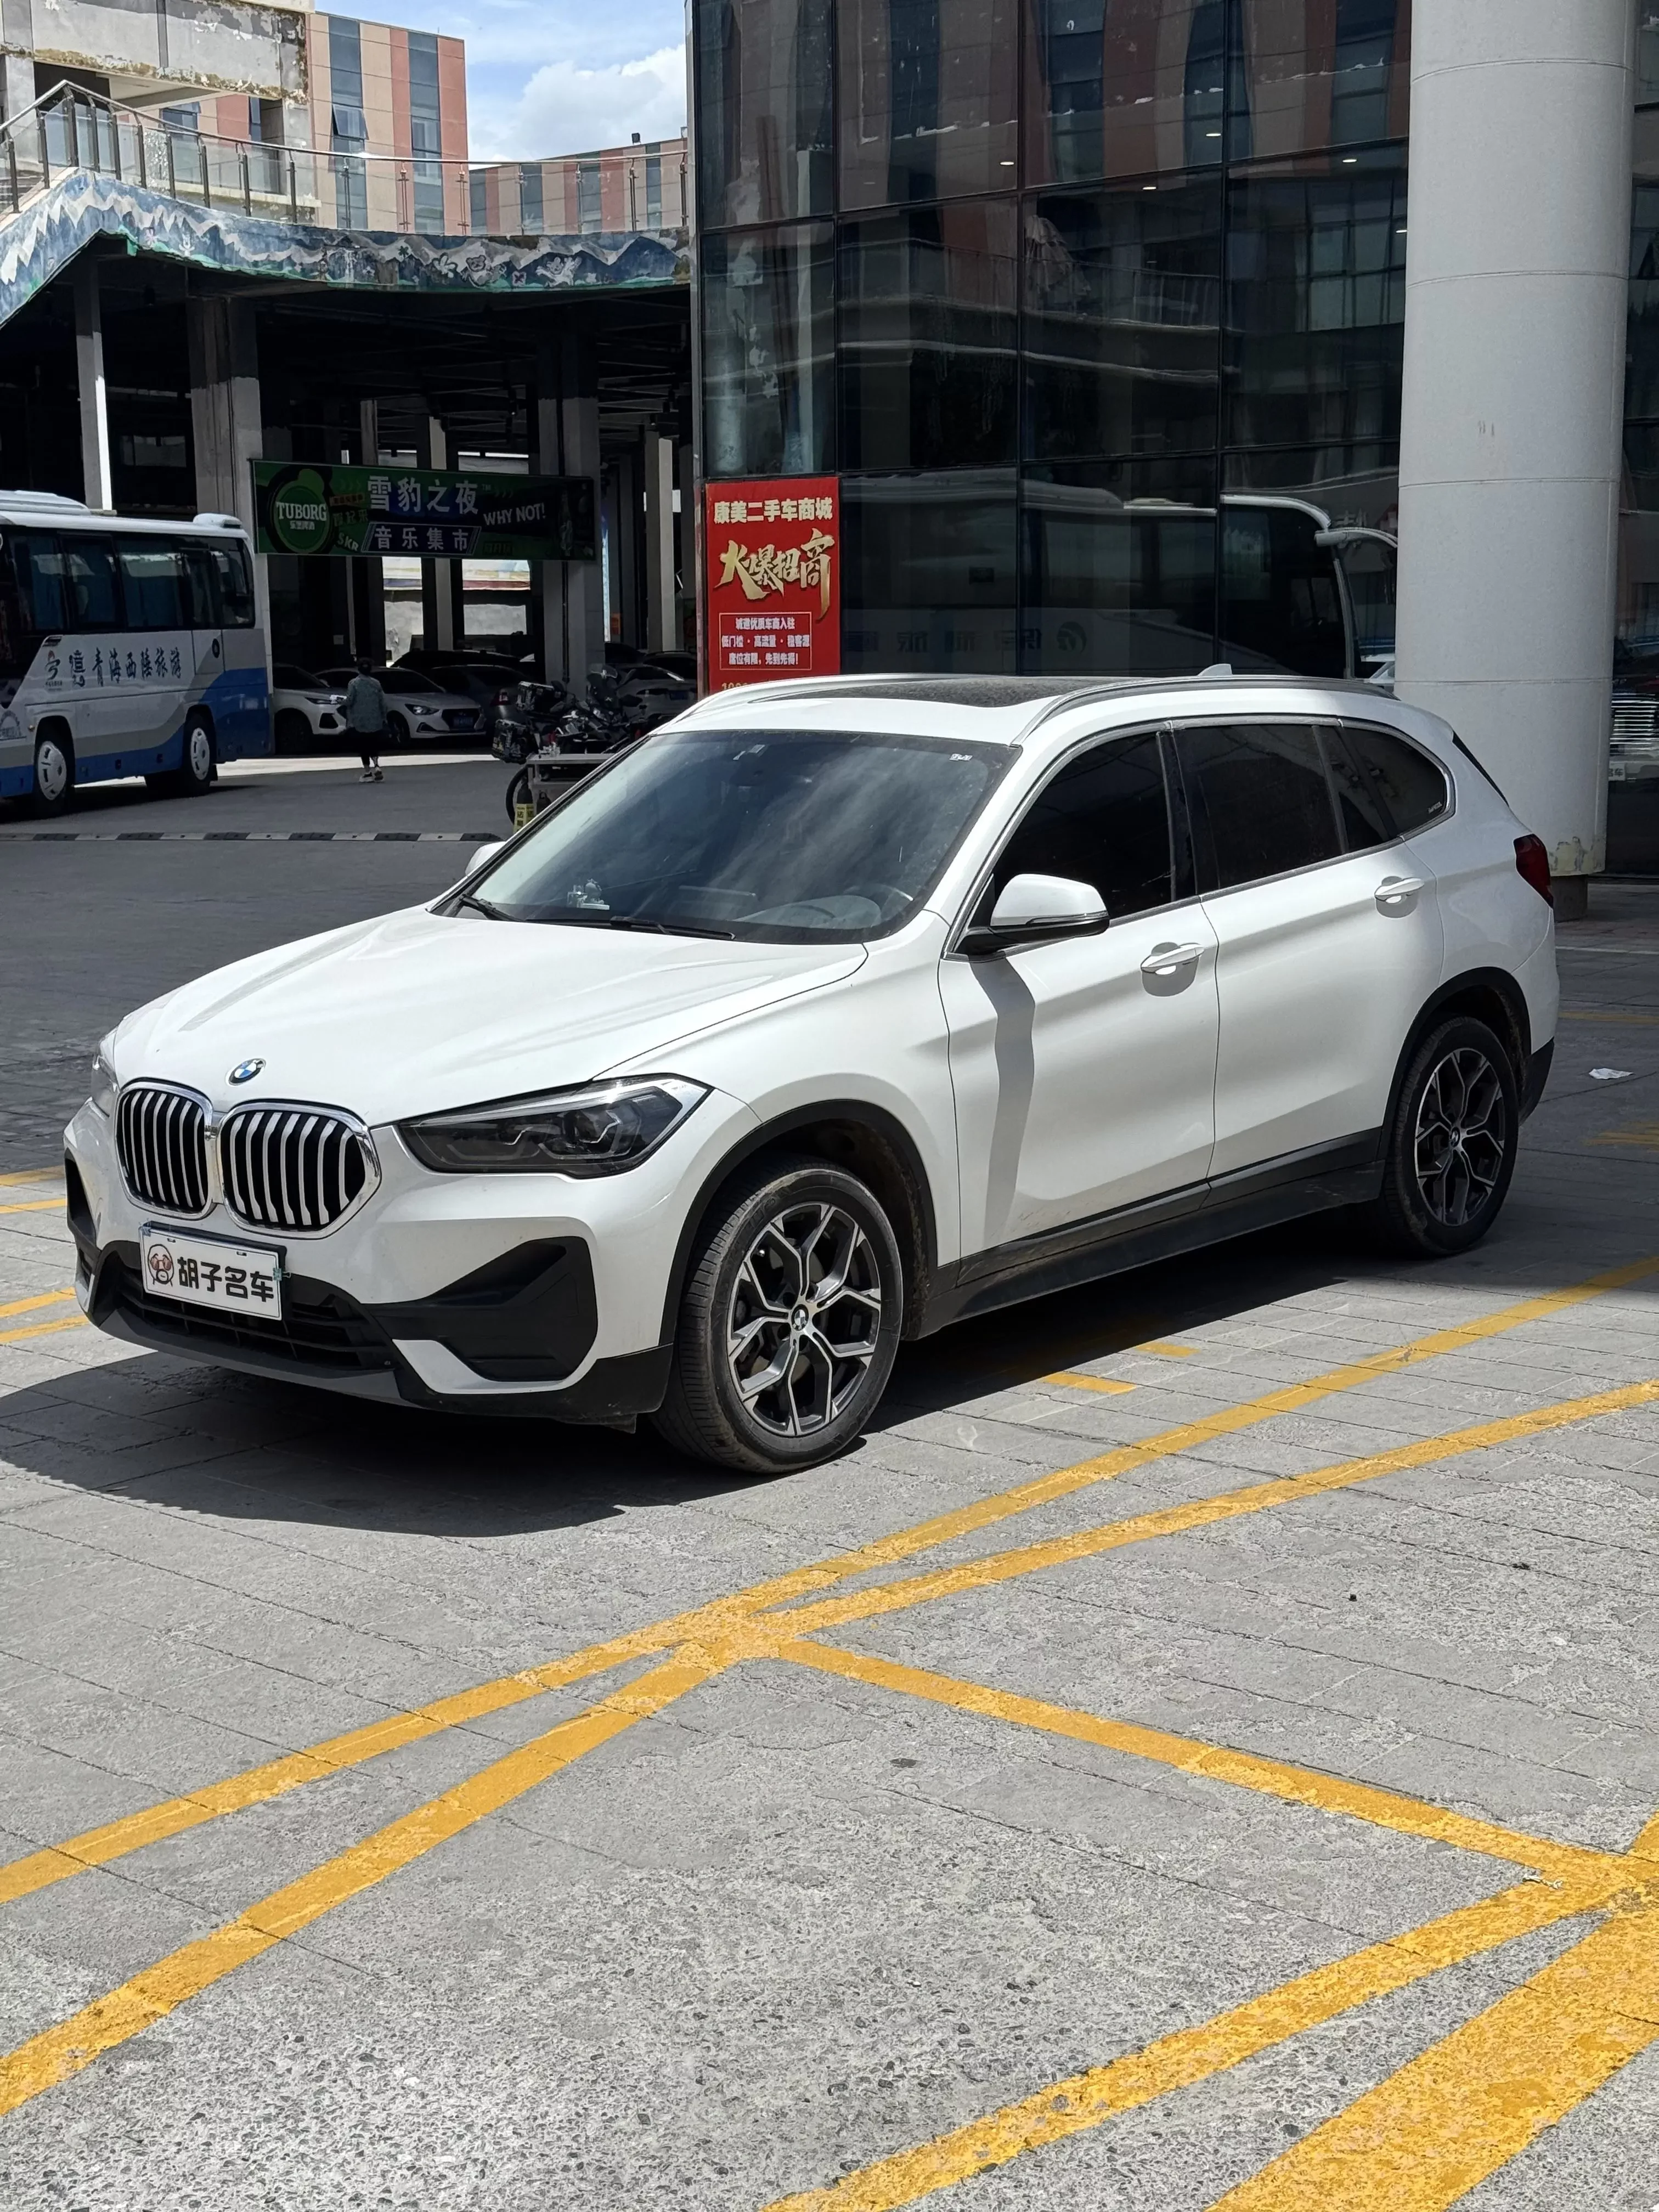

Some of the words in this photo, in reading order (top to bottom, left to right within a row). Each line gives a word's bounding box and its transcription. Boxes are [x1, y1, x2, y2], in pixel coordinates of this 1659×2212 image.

[367, 475, 478, 514] 雪豹之夜
[275, 501, 327, 521] TUBORG
[483, 509, 512, 526] WHY
[516, 502, 546, 522] NOT!
[714, 497, 833, 524] 康美二手车商城
[374, 525, 469, 551] 音乐集市
[714, 528, 834, 620] 火爆招商
[177, 1256, 274, 1302] 胡子名车
